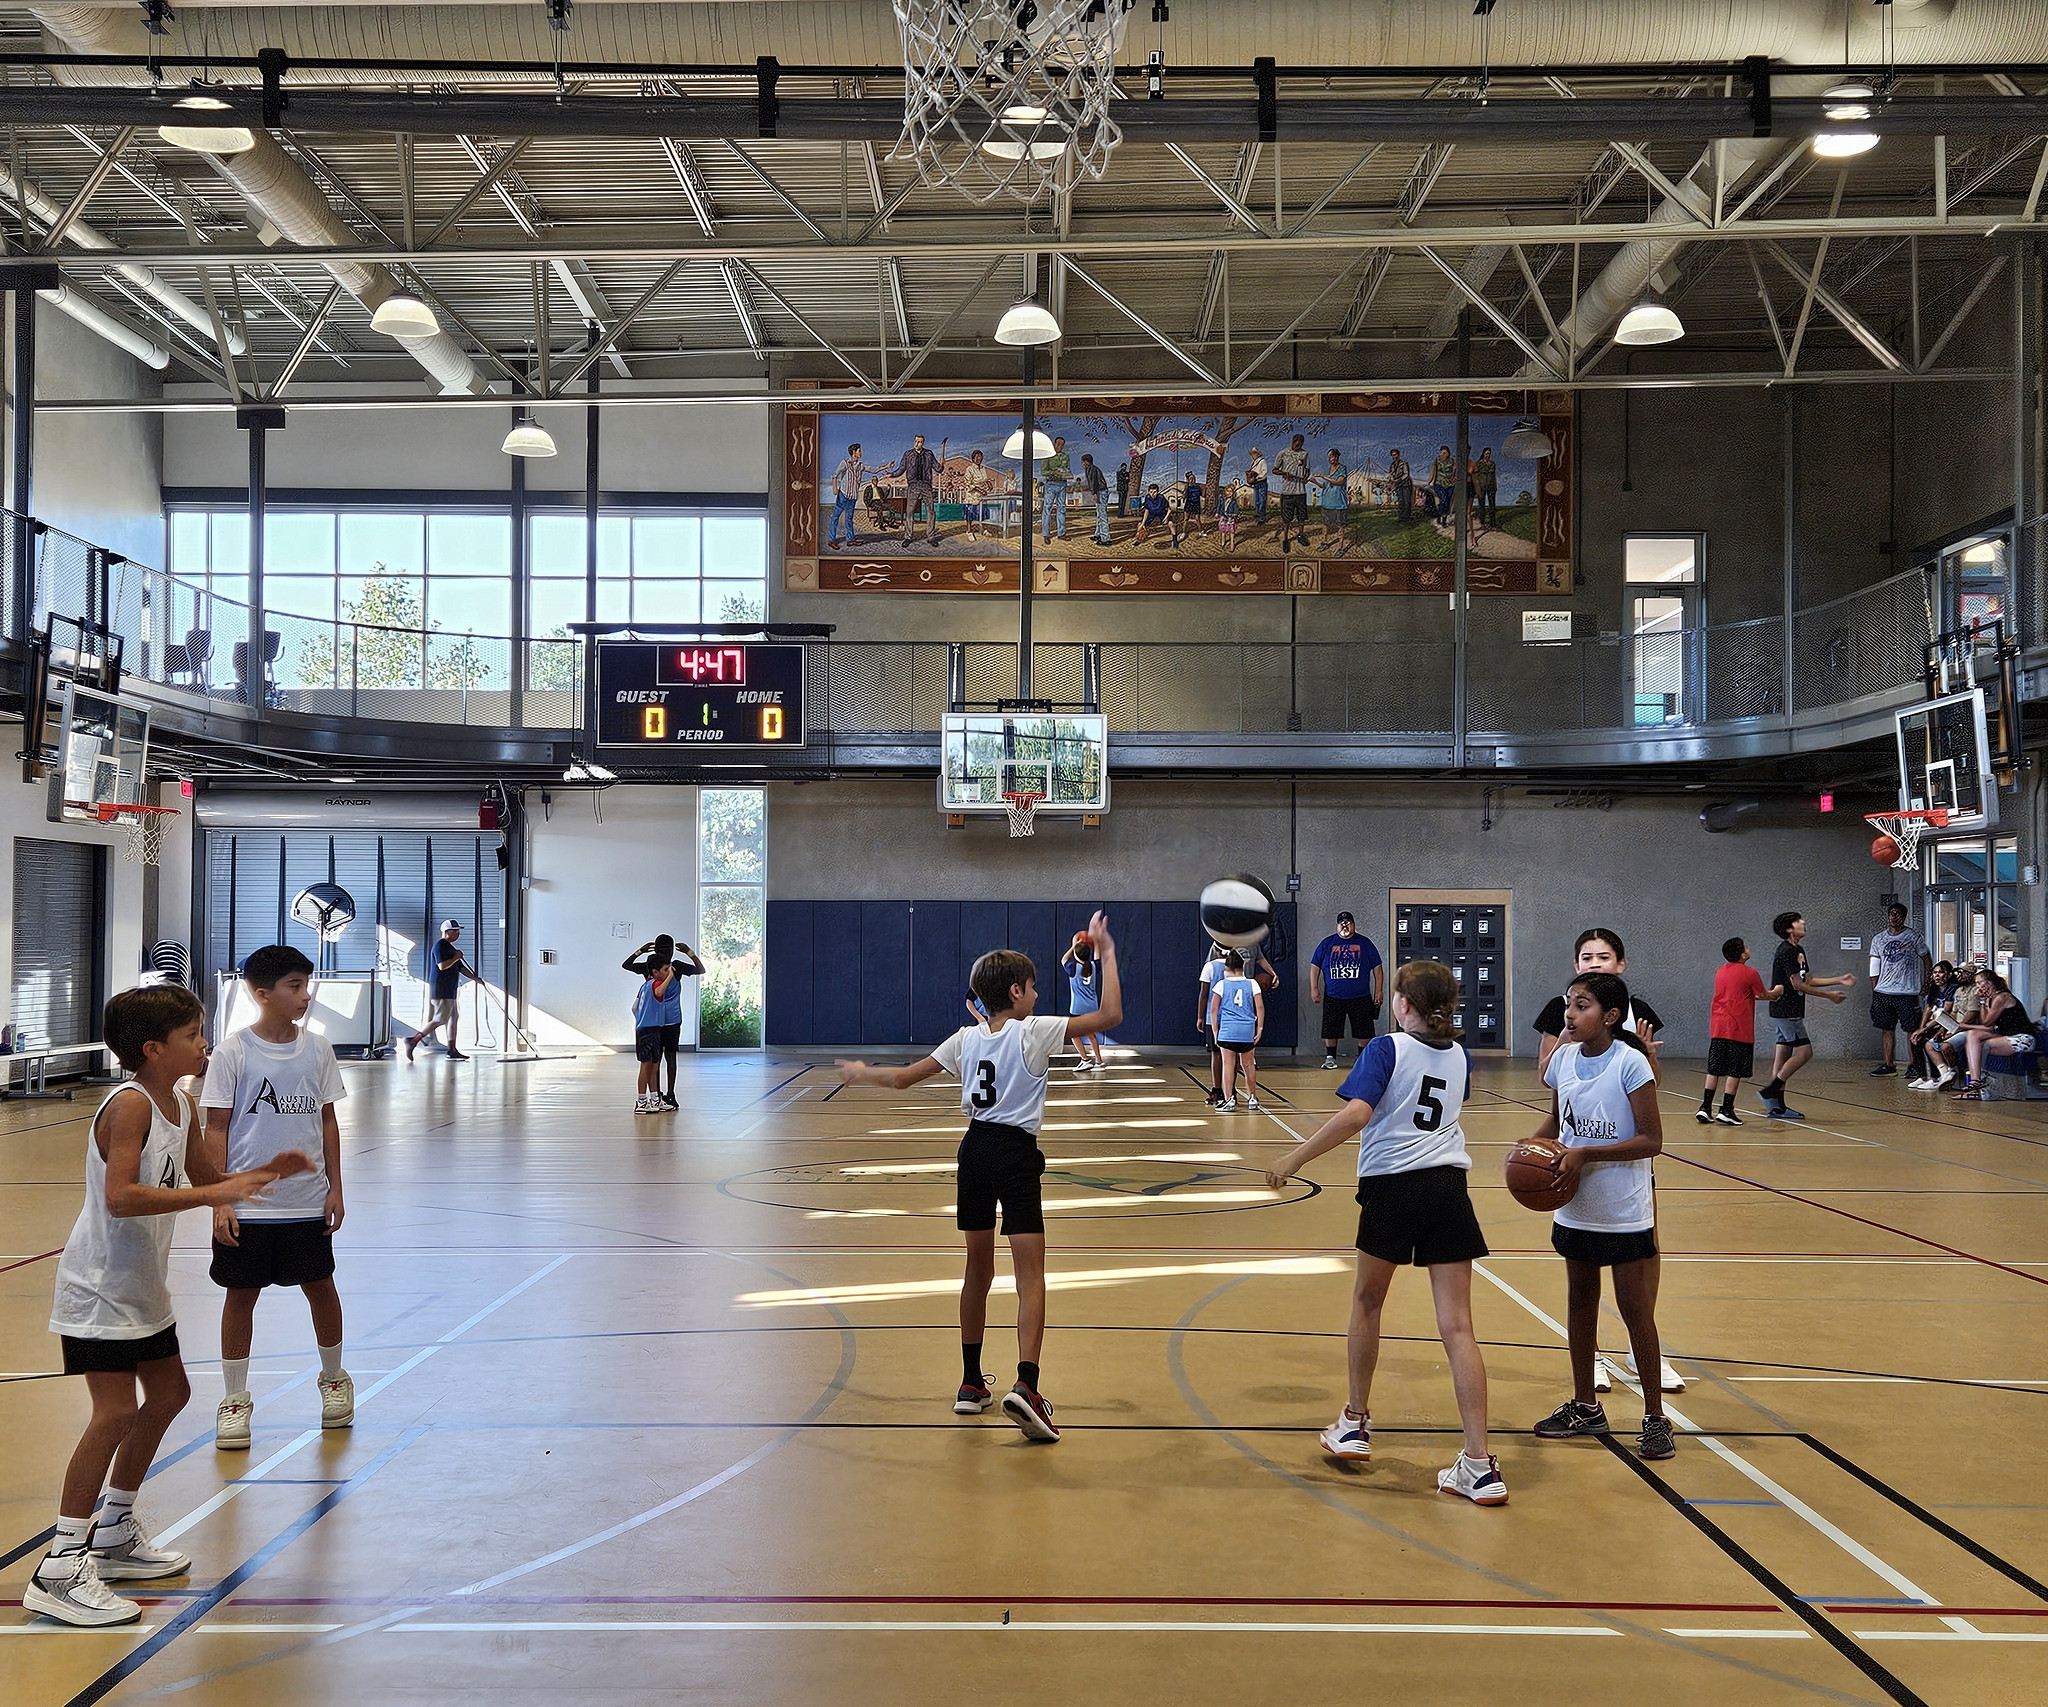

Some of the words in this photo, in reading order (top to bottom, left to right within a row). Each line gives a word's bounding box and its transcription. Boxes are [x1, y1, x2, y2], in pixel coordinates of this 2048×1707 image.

[680, 649, 741, 681] 4:47
[615, 690, 669, 704] GUEST
[736, 690, 783, 704] HOME
[645, 707, 664, 739] 0
[702, 702, 709, 726] 1
[763, 707, 782, 739] 0
[677, 729, 724, 741] PERIOD
[1331, 968, 1360, 979] REST
[1234, 988, 1244, 1007] 4
[971, 1060, 997, 1109] 3
[1412, 1074, 1447, 1132] 5
